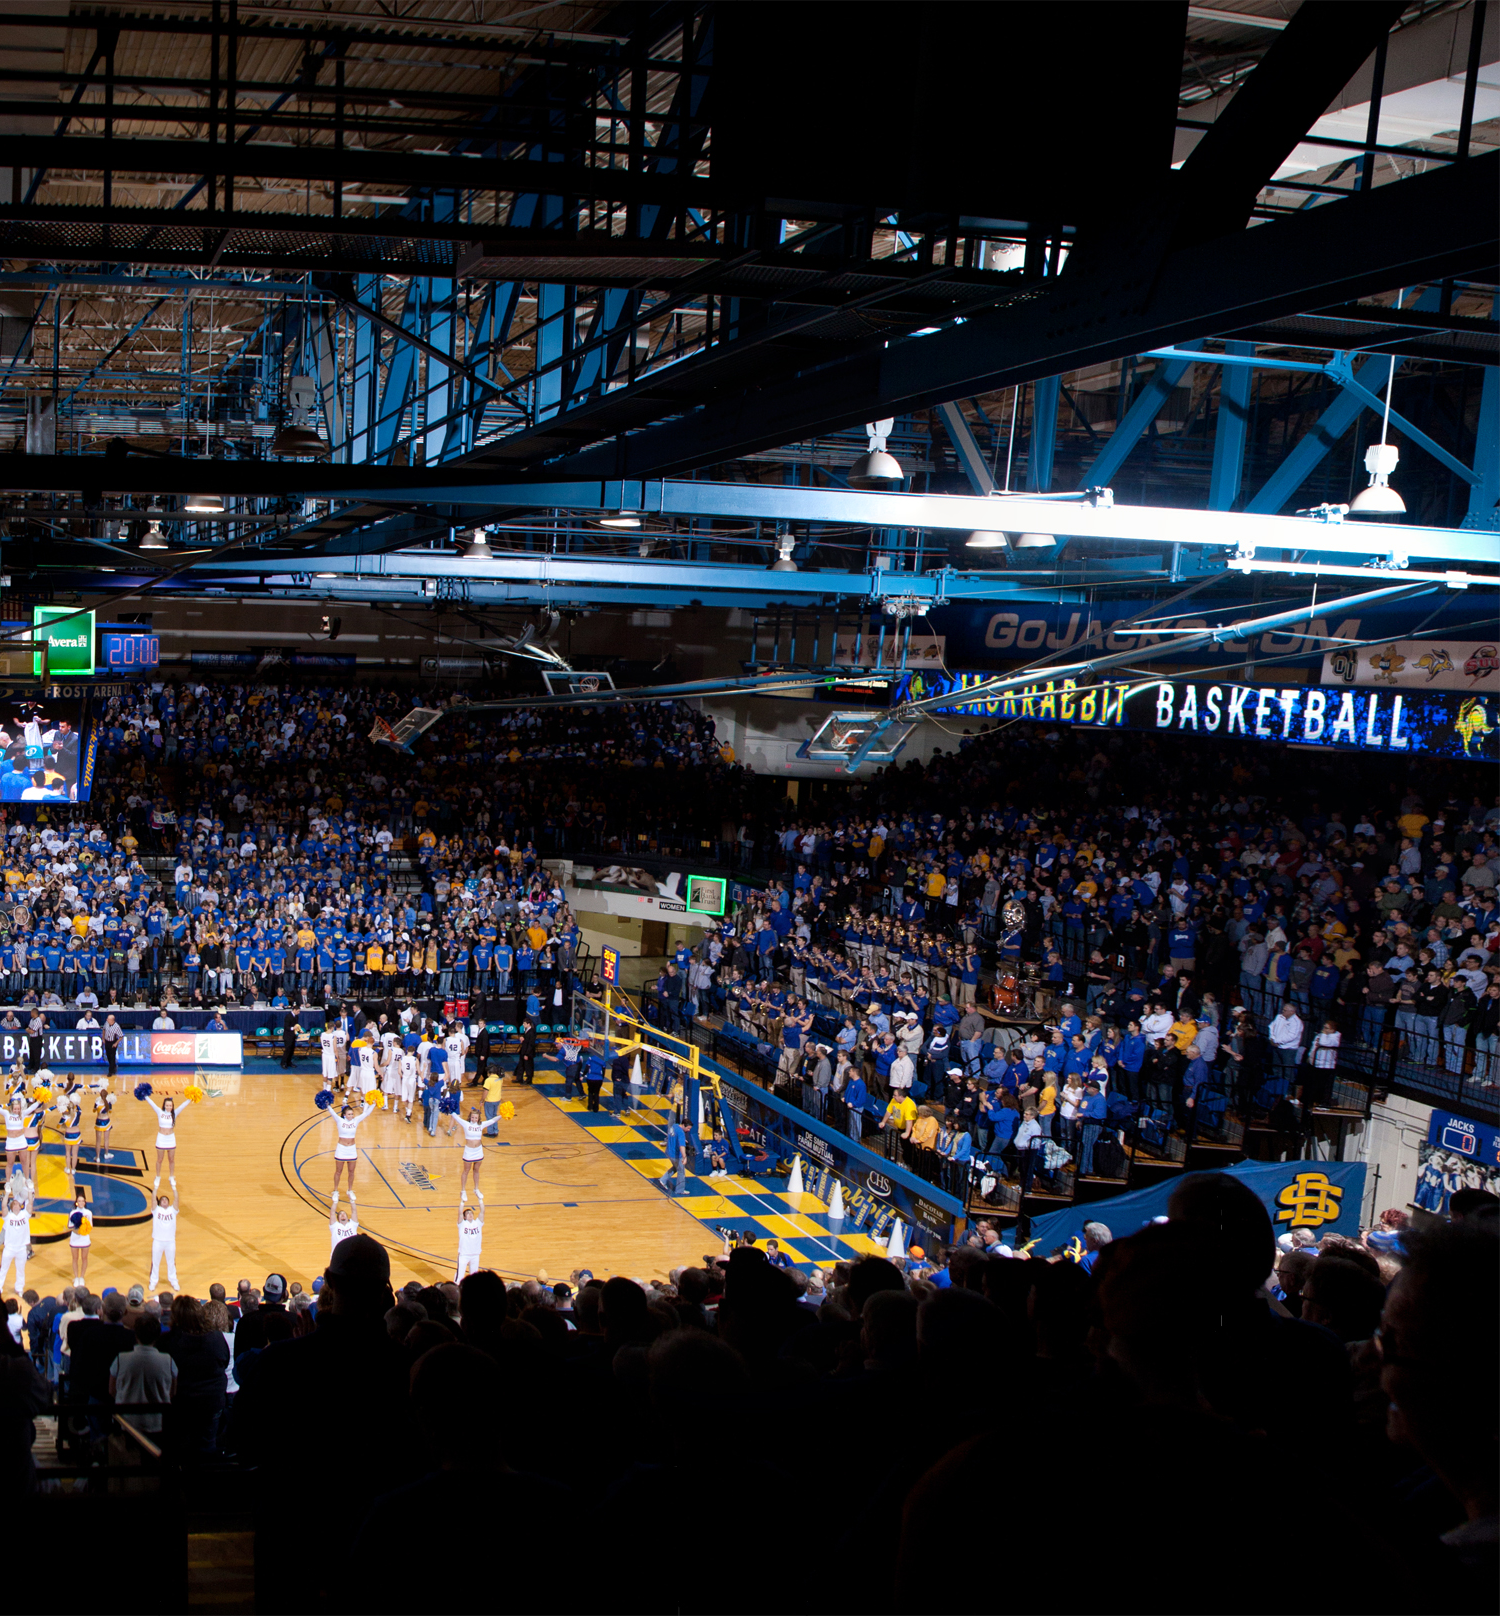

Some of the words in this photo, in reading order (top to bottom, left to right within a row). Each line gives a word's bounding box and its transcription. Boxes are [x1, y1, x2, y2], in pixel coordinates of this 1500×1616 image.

[110, 637, 159, 664] 20:00
[44, 686, 88, 698] FROST
[94, 685, 123, 697] ARENA
[1155, 683, 1408, 749] BASKETBALL
[700, 887, 715, 895] First
[660, 902, 686, 911] WOMEN
[1117, 955, 1126, 968] R
[604, 960, 615, 980] 35
[341, 1122, 356, 1130] STATE
[1447, 1117, 1475, 1134] JACKS
[797, 1134, 812, 1147] FARM
[812, 1140, 835, 1163] MUTUAL
[813, 1136, 829, 1151] SMET
[399, 1162, 437, 1191] SUMMIT
[869, 1170, 891, 1192] CHS
[853, 1204, 869, 1227] NOISE
[918, 1199, 944, 1219] DACOTAH
[9, 1218, 26, 1227] STATE
[156, 1213, 173, 1221] STATE
[922, 1211, 937, 1225] BANK
[338, 1228, 353, 1237] STATE
[464, 1227, 480, 1236] STATE
